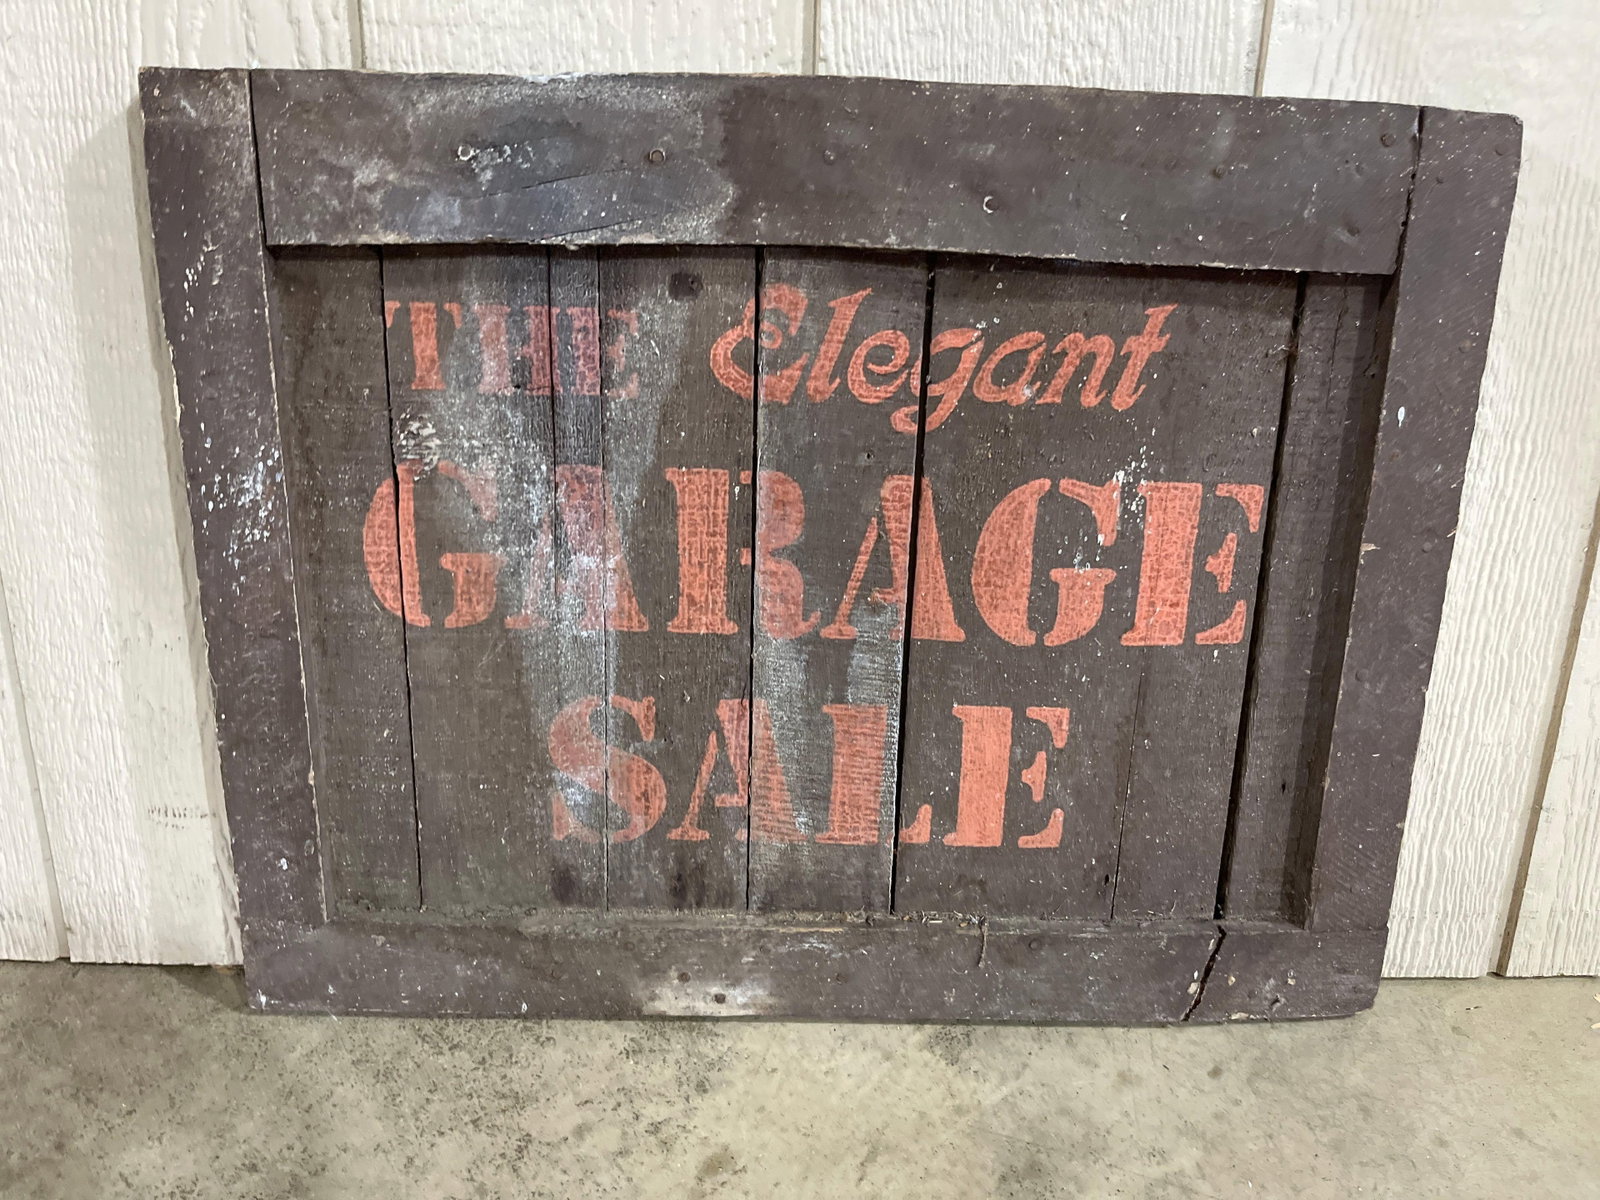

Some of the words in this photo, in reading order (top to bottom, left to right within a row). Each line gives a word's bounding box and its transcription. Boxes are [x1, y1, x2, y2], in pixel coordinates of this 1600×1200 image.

[384, 301, 640, 399] THE
[710, 285, 1178, 433] Elegant
[363, 463, 1266, 646] GARAGE
[547, 696, 1071, 847] SALE
